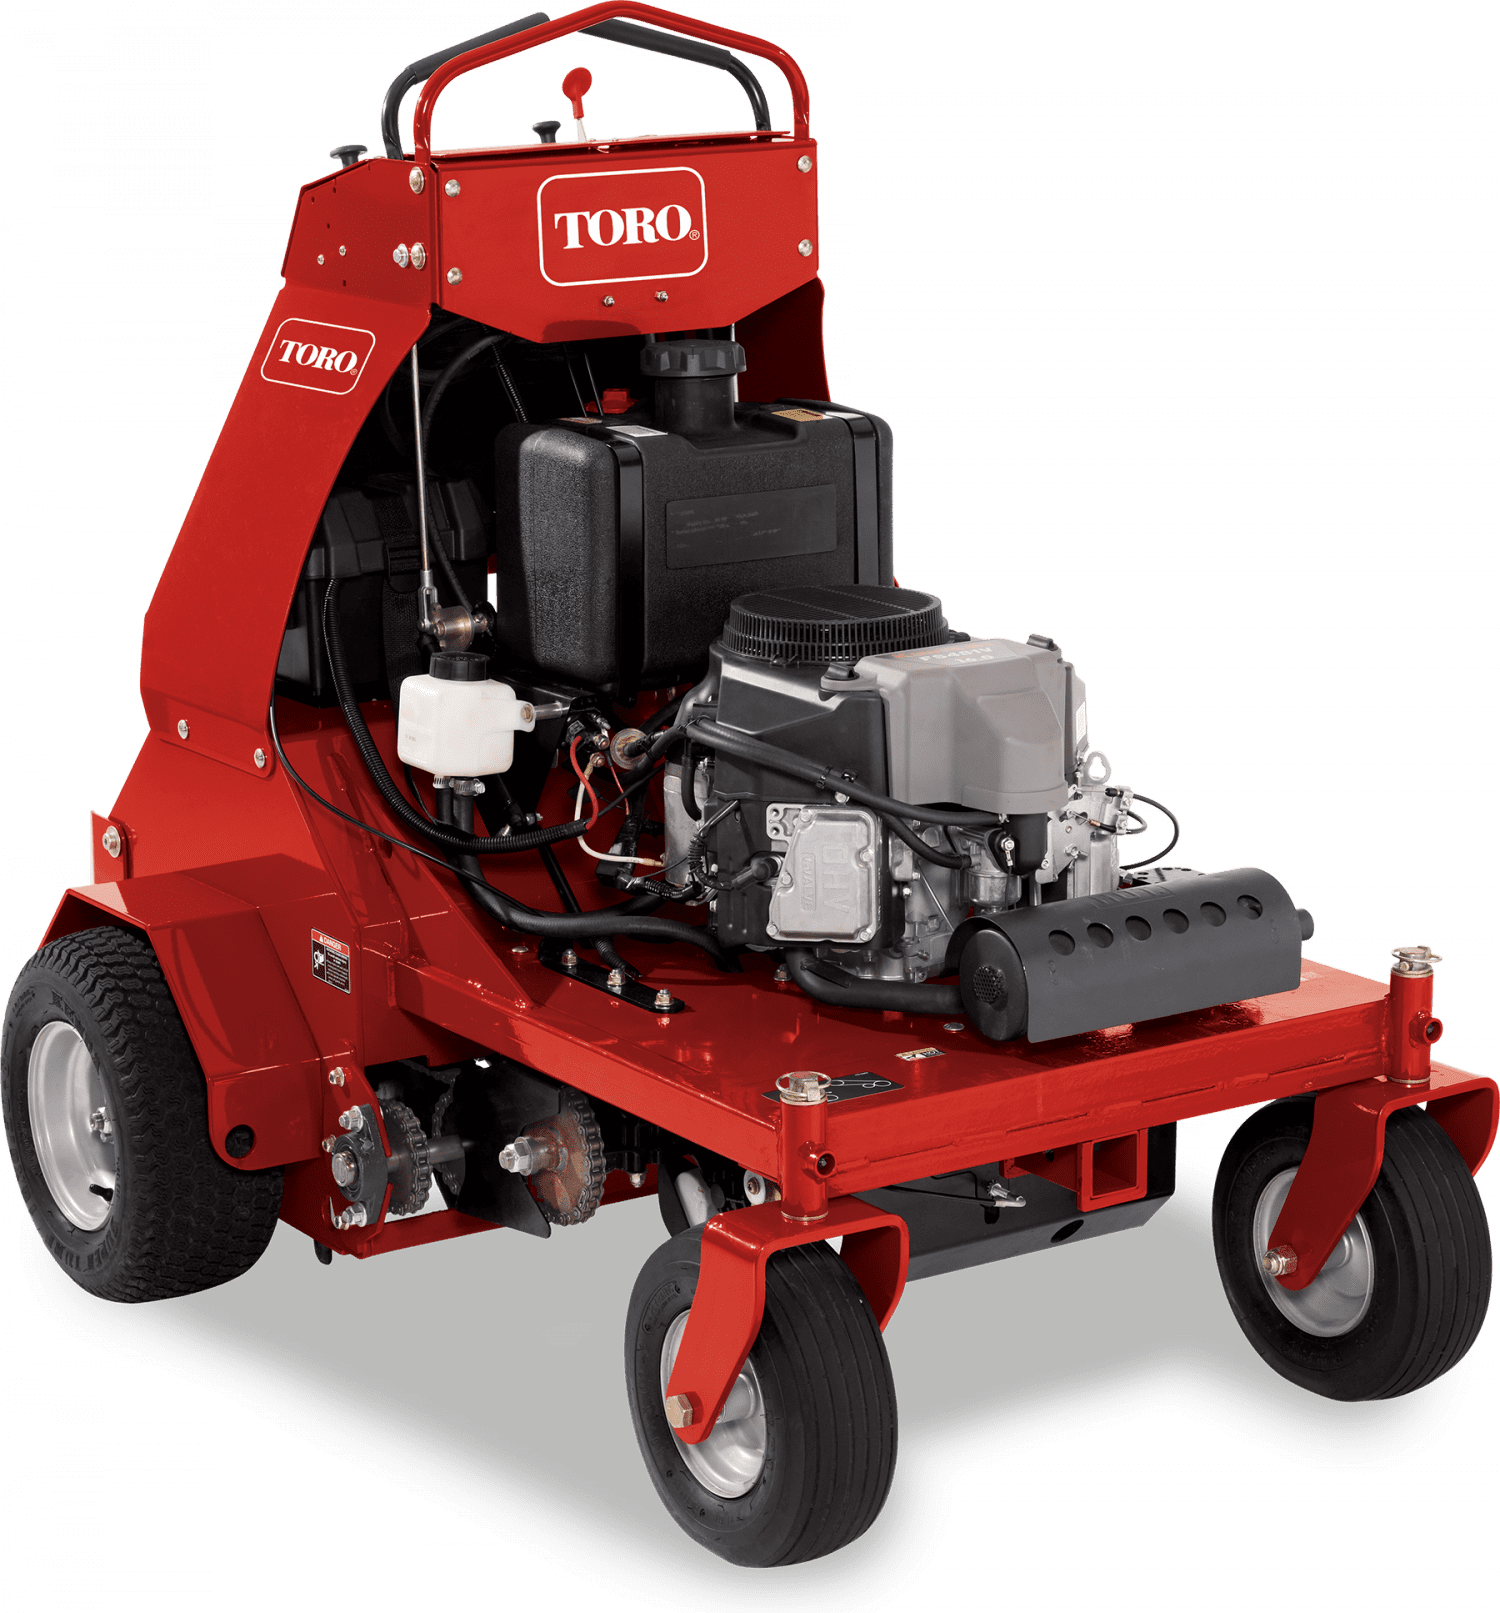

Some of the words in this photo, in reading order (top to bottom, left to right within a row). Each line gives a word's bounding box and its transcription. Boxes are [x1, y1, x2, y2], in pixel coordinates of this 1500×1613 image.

[554, 204, 691, 249] TORO
[278, 339, 358, 373] TORO
[324, 937, 342, 951] DANGER
